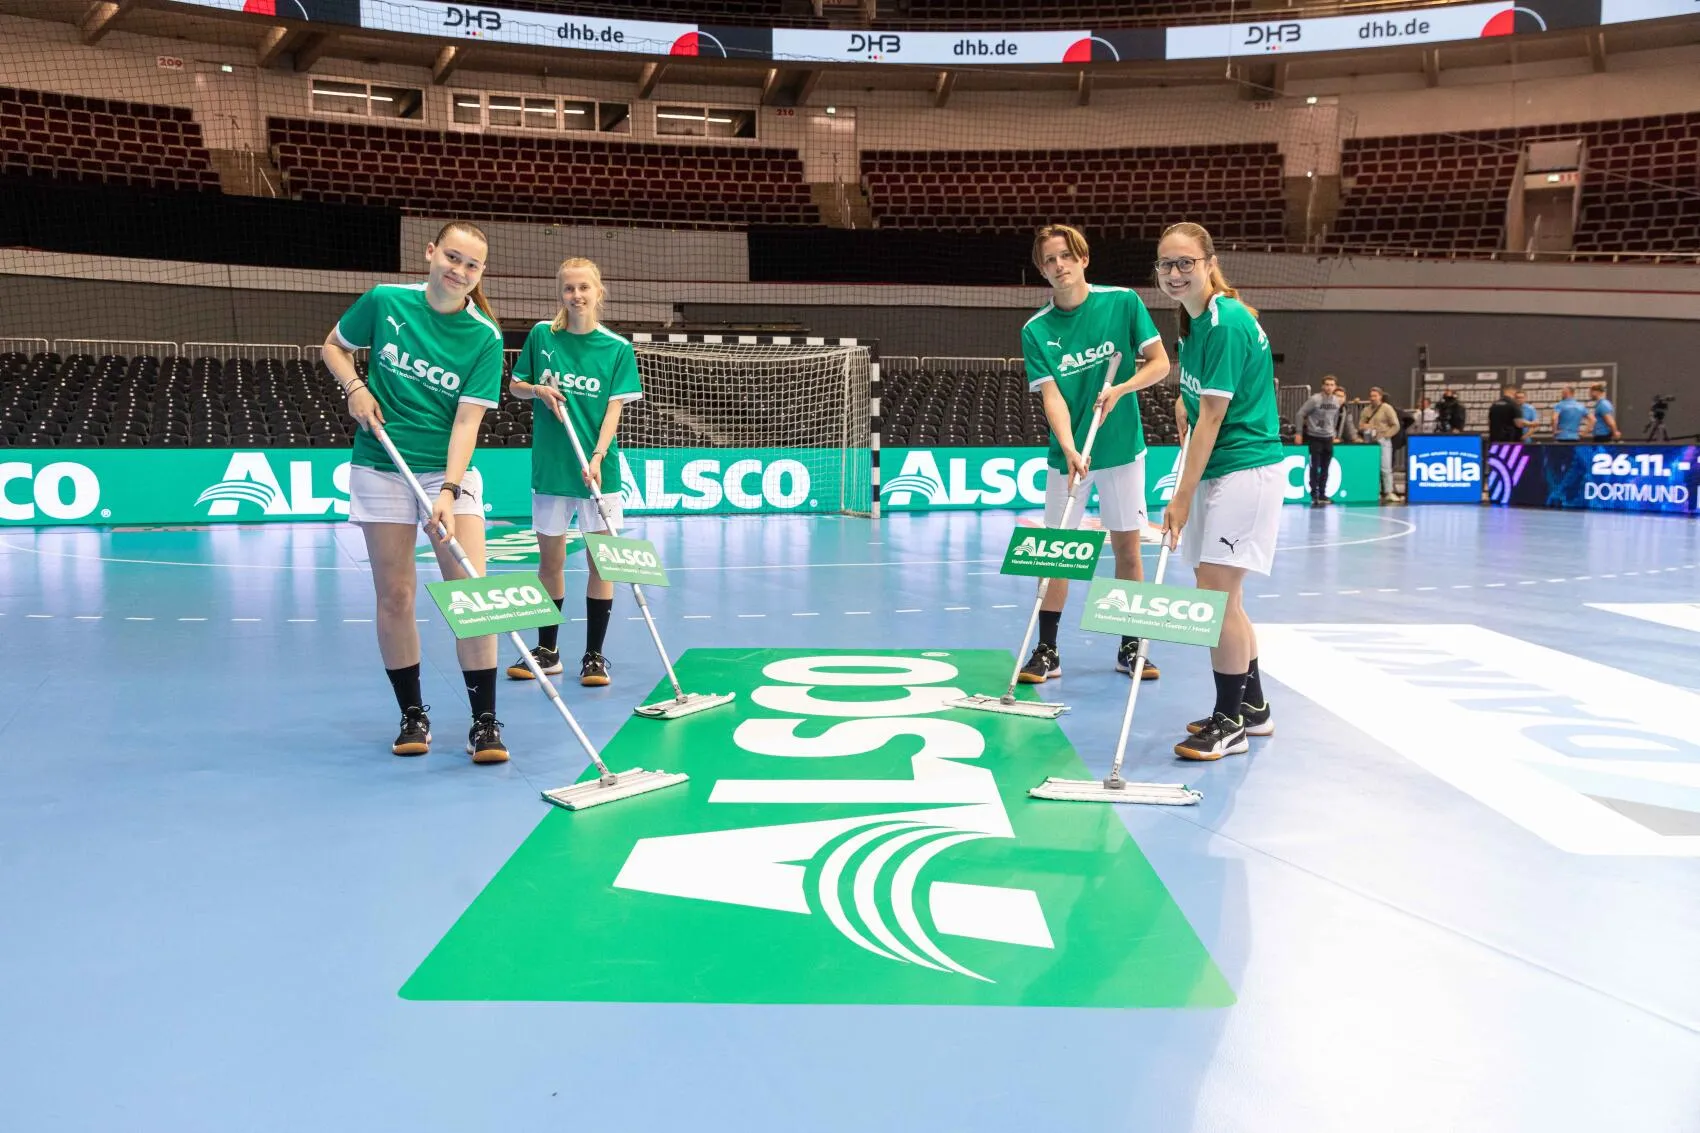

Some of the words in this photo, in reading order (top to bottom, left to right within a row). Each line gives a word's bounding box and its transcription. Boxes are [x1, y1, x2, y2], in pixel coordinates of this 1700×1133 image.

[443, 7, 501, 31] DHB
[557, 22, 624, 43] dhb.de
[1244, 23, 1301, 45] DHB
[1358, 18, 1430, 39] dhb.de
[847, 34, 901, 53] DHB
[953, 39, 1018, 56] dhb.de
[159, 57, 183, 68] 209
[378, 342, 460, 391] ALSCO
[1057, 341, 1115, 372] ALSCO
[539, 368, 601, 392] ALSCO
[1409, 454, 1481, 482] hella
[1591, 453, 1672, 477] 26.11.
[1584, 482, 1689, 504] DORTMUND
[594, 543, 657, 568] ALSCO
[1012, 536, 1095, 561] ALSCO
[448, 585, 543, 615] ALSCO
[1094, 588, 1214, 623] ALSCO
[612, 655, 1056, 984] ALSCO
